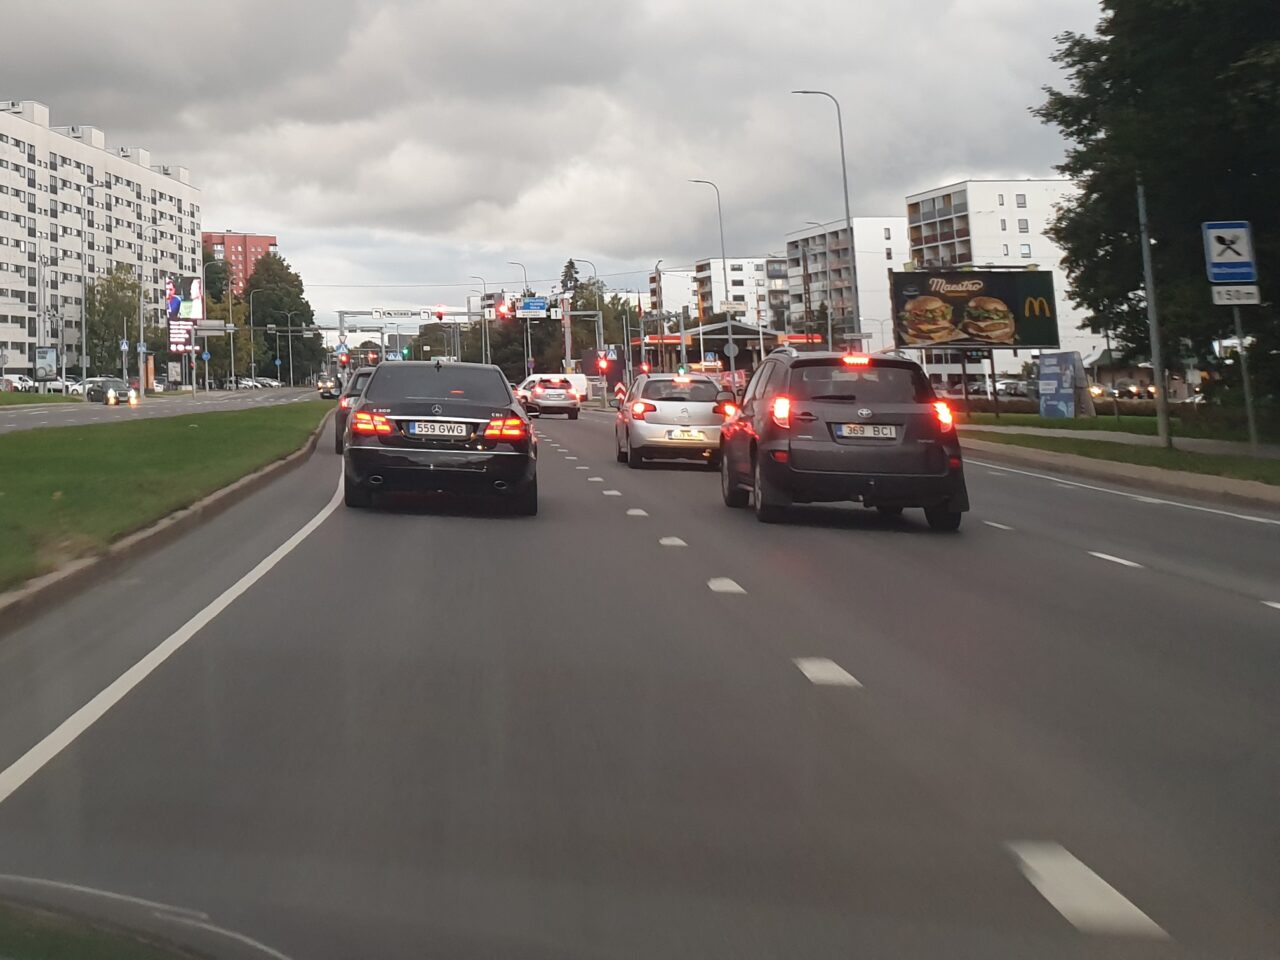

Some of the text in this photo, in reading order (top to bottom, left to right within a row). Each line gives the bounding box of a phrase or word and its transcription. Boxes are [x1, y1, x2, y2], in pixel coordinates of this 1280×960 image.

[929, 278, 983, 293] Maestro
[417, 423, 464, 435] 559 GWG
[847, 426, 865, 435] 369
